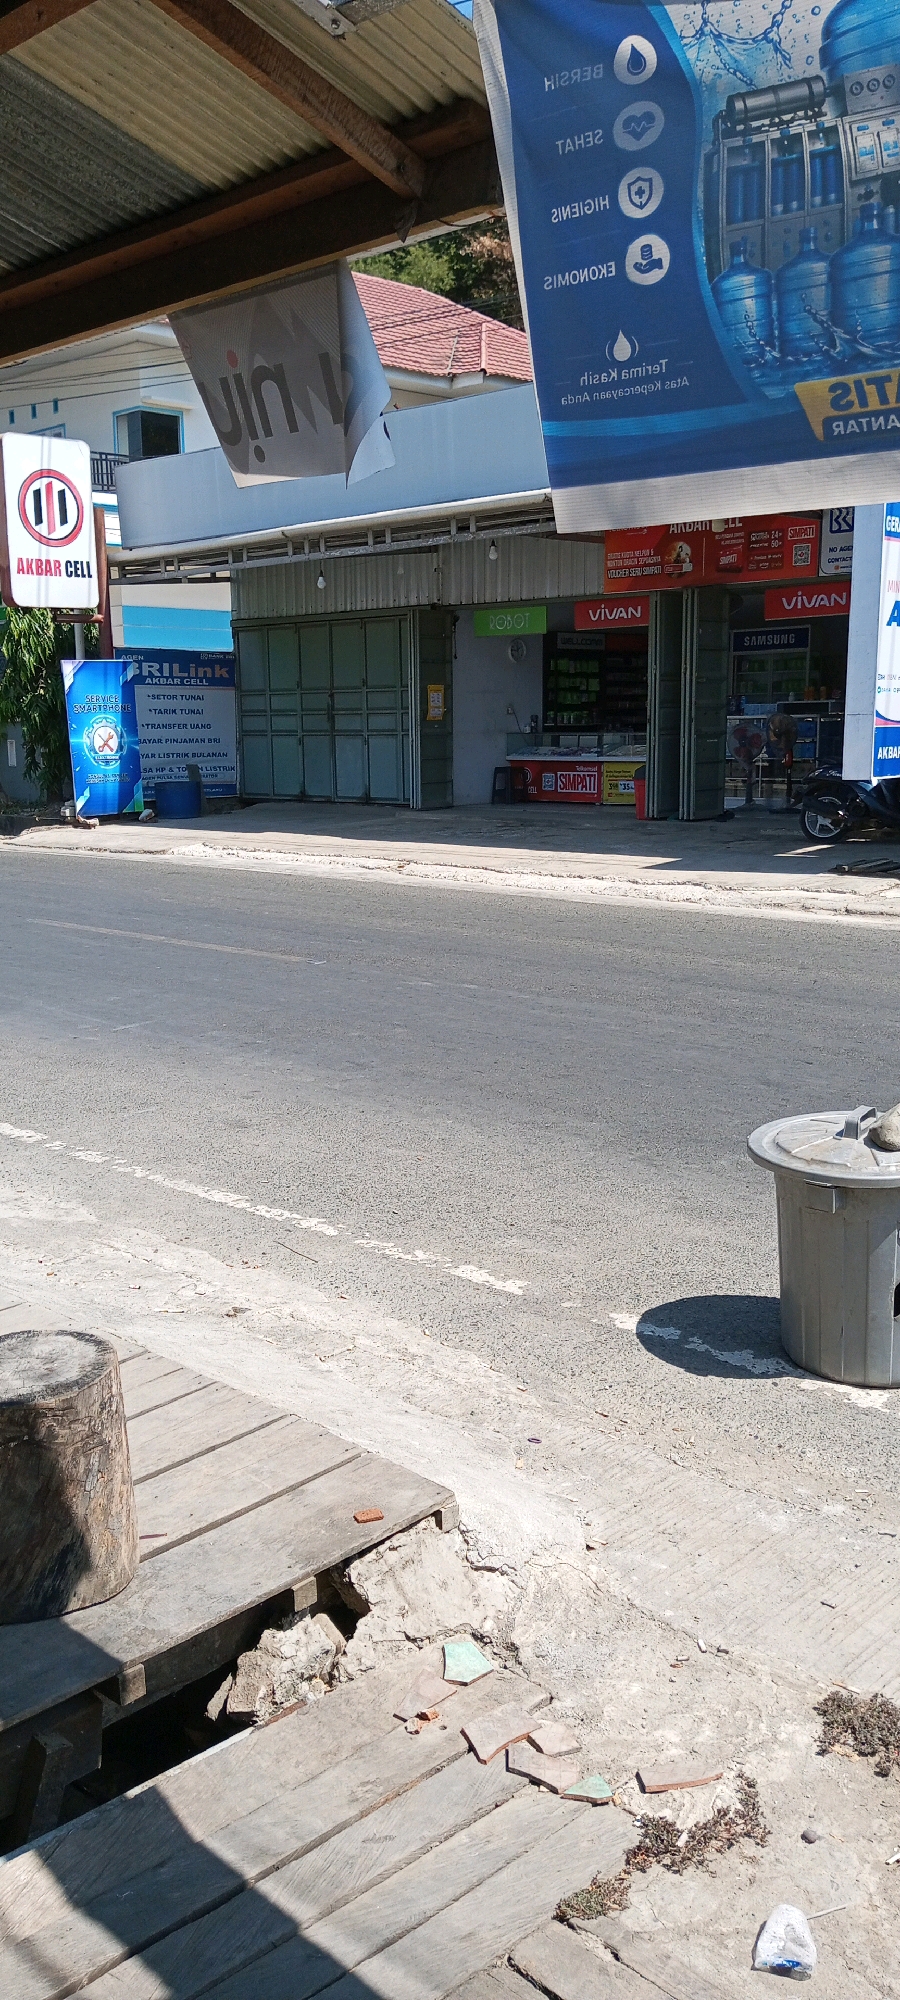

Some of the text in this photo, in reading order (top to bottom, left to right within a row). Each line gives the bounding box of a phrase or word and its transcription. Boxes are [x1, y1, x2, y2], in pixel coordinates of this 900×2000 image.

[886, 515, 900, 533] GER
[789, 526, 814, 539] SIMPATI
[16, 557, 93, 579] AKBAR CELL
[887, 579, 900, 594] MIN
[489, 612, 531, 630] ROBOT
[743, 633, 796, 647] SAMSUNG
[183, 678, 209, 686] CELL
[84, 693, 120, 703] SERVICE
[73, 703, 132, 714] SMARTPHONE
[176, 765, 203, 773] TON
[205, 764, 236, 772] LISTRIK
[559, 773, 597, 792] SIMPATI
[527, 786, 538, 794] CELL
